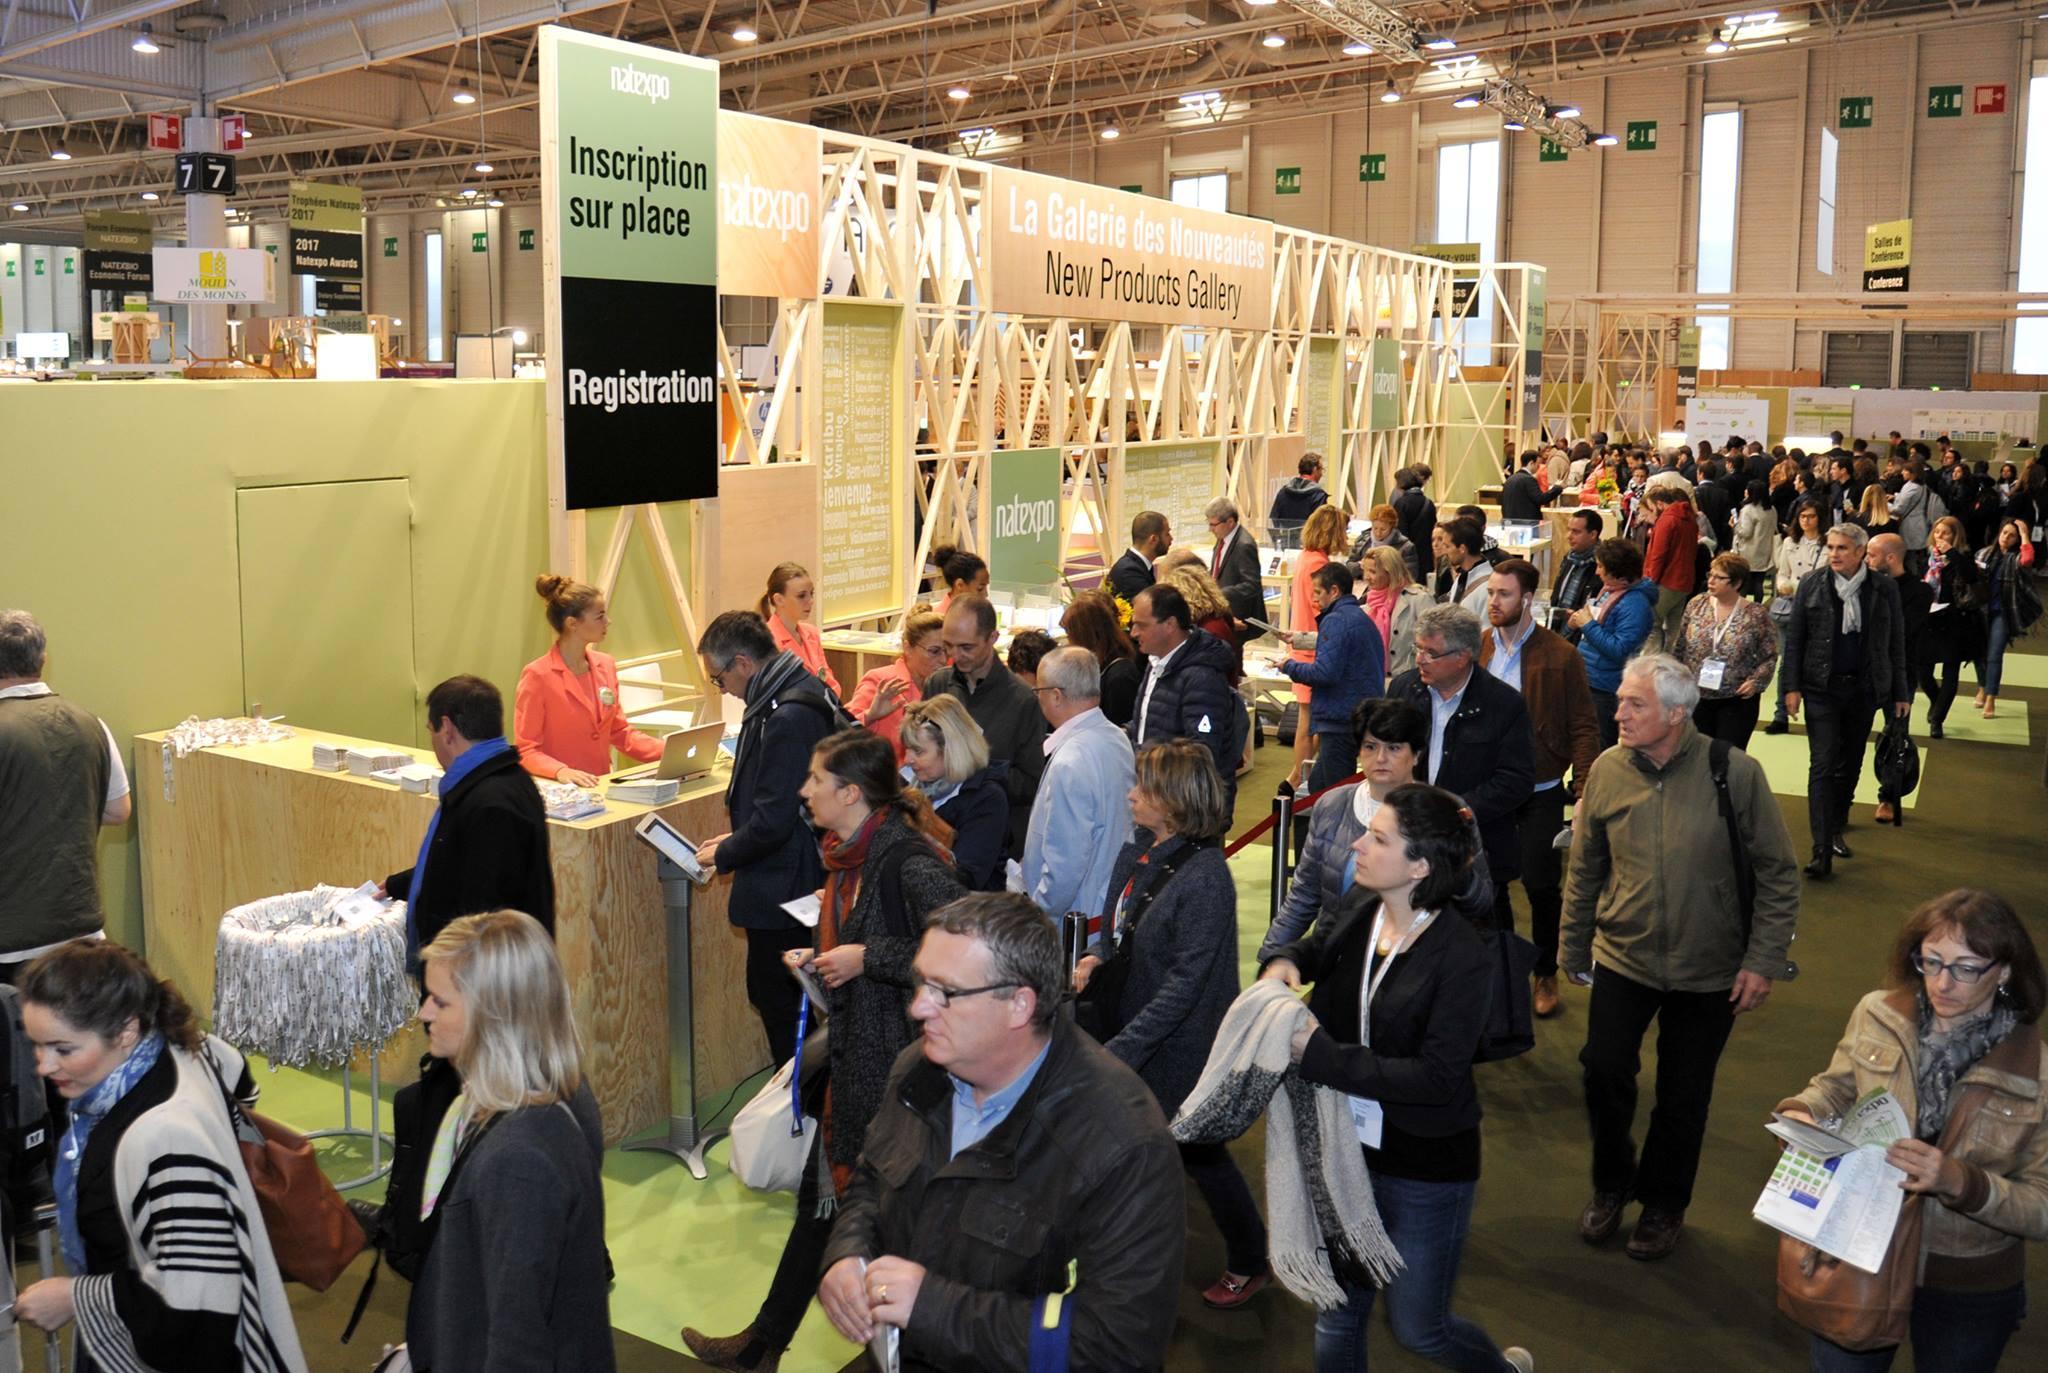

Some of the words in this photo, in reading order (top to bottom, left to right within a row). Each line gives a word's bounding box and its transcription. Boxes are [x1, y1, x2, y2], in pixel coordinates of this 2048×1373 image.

[611, 62, 670, 104] natexpo
[181, 164, 193, 188] 7
[208, 164, 226, 188] 7
[570, 136, 707, 192] Inscription
[292, 195, 328, 208] Trophées
[330, 198, 360, 211] Natexpo
[292, 208, 315, 221] 2017
[719, 175, 809, 242] natexpo
[570, 197, 613, 229] sur
[622, 196, 690, 240] place
[1009, 185, 1038, 236] La
[1047, 192, 1127, 249] Galerie
[1133, 210, 1165, 255] des
[1170, 217, 1265, 269] Nouveautés
[295, 238, 320, 252] 2017
[1874, 237, 1893, 249] Salles
[1894, 235, 1902, 246] de
[296, 255, 329, 269] Natexpo
[329, 257, 358, 269] Awards
[89, 269, 125, 280] Economic
[127, 271, 150, 281] Forum
[187, 278, 237, 288] MOULIN
[1046, 250, 1093, 298] New
[1100, 257, 1181, 307] Products
[1187, 269, 1242, 320] Gallery
[1868, 276, 1904, 290] Conference
[177, 290, 198, 299] DES
[201, 290, 247, 299] MOINES
[568, 368, 713, 413] Registration
[823, 411, 834, 479] Karibu
[823, 480, 872, 508] ienvenue
[996, 493, 1055, 543] natexpo
